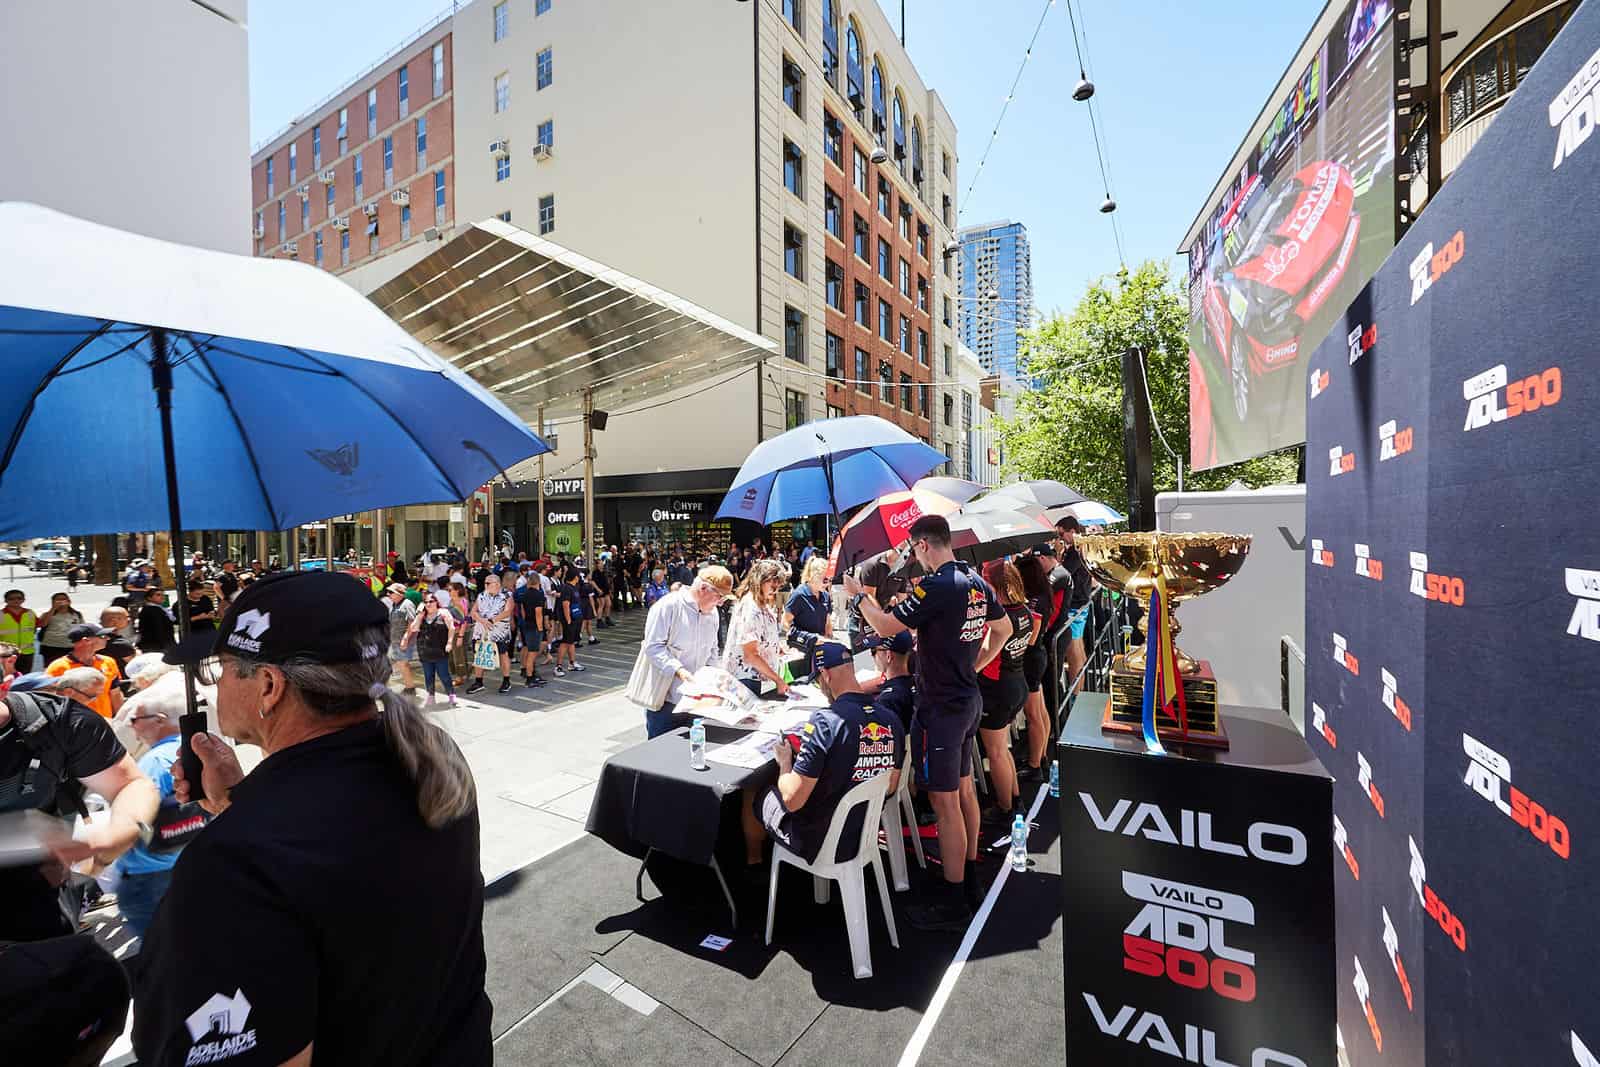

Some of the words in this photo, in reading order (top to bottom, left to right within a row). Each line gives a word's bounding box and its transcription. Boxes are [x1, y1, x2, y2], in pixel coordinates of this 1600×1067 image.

[555, 513, 579, 522] HYPE
[662, 510, 690, 520] HYPE
[854, 756, 895, 768] AMPOL
[1078, 791, 1307, 866] VAILO
[1150, 883, 1223, 910] VAILO
[1123, 903, 1255, 966] ADL
[1123, 934, 1256, 1003] 500
